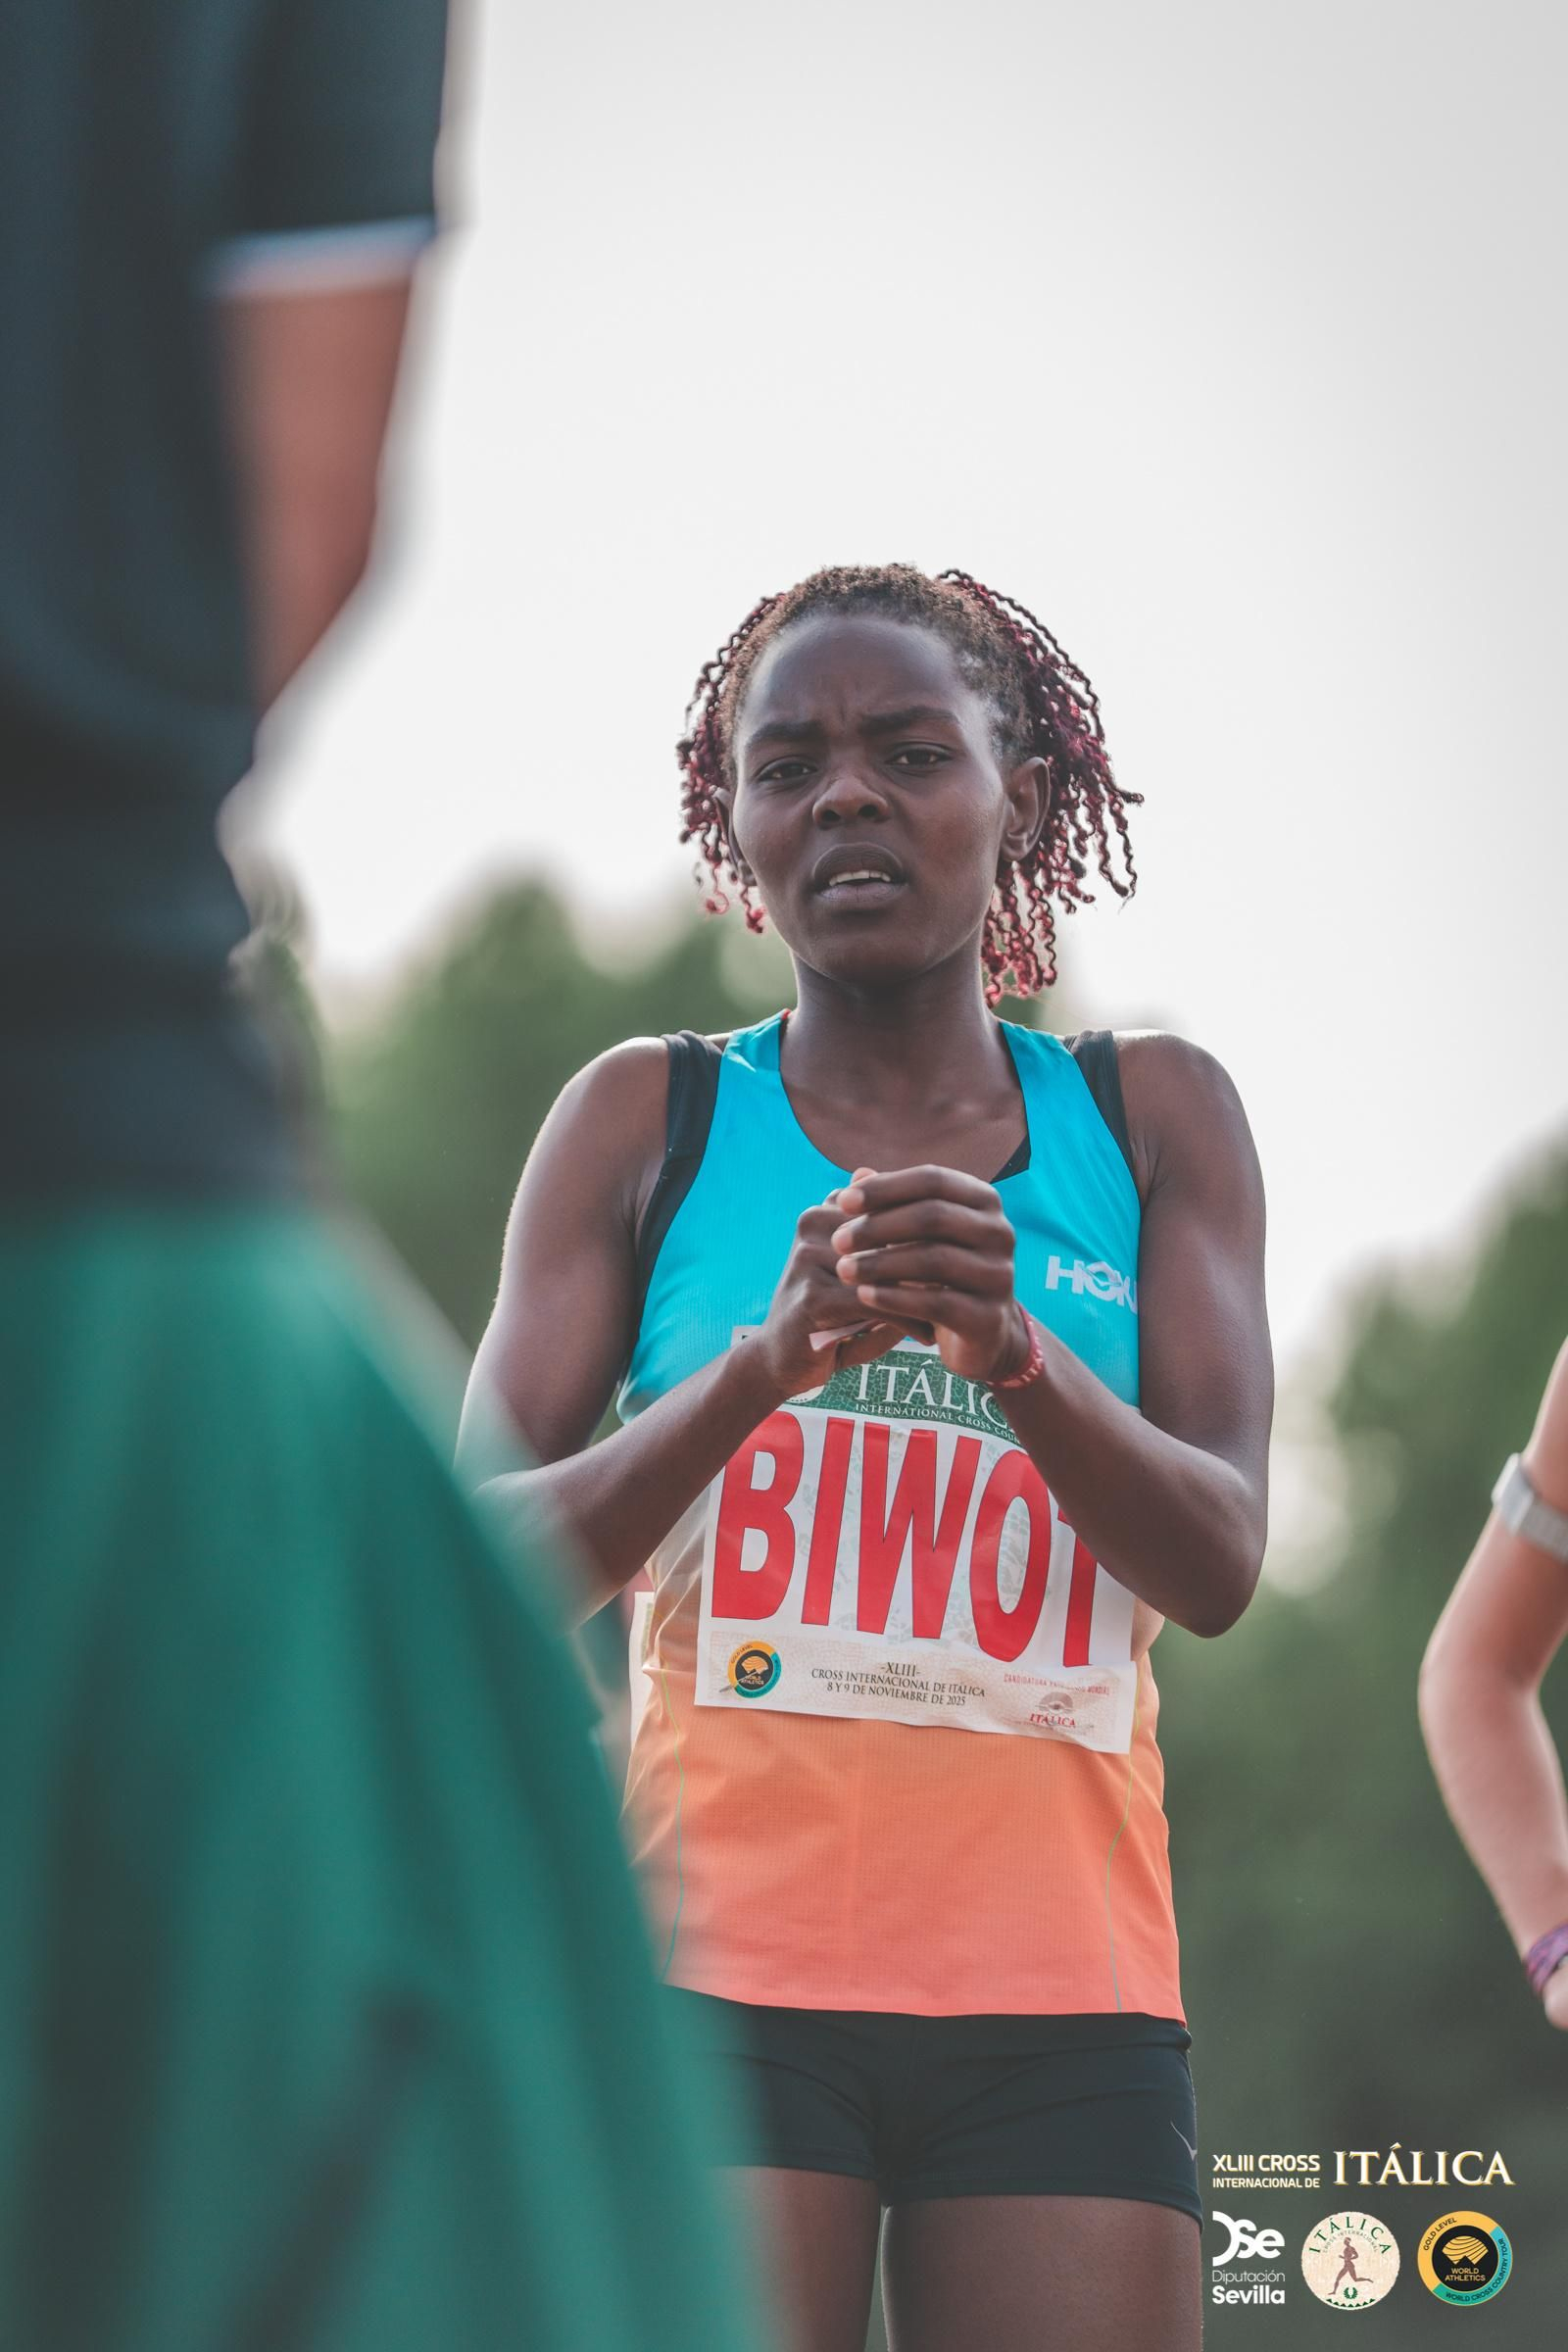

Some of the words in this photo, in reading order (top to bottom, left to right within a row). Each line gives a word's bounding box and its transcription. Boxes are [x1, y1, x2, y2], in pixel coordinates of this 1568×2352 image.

[1045, 1254, 1138, 1314] HOK
[855, 1358, 1015, 1434] ITÁLIC
[856, 1403, 954, 1421] INTERNATIONAL
[957, 1414, 991, 1432] CROSS
[811, 1668, 843, 1681] CROSS
[846, 1672, 930, 1691] INTERNACIONAL
[933, 1683, 947, 1693] DE
[827, 1682, 833, 1691] 8
[835, 1683, 842, 1693] Y
[844, 1684, 850, 1693] 9
[853, 1685, 866, 1695] DE
[868, 1687, 928, 1703] NOVIEMBRE
[931, 1694, 944, 1705] DE
[946, 1696, 966, 1707] 2025
